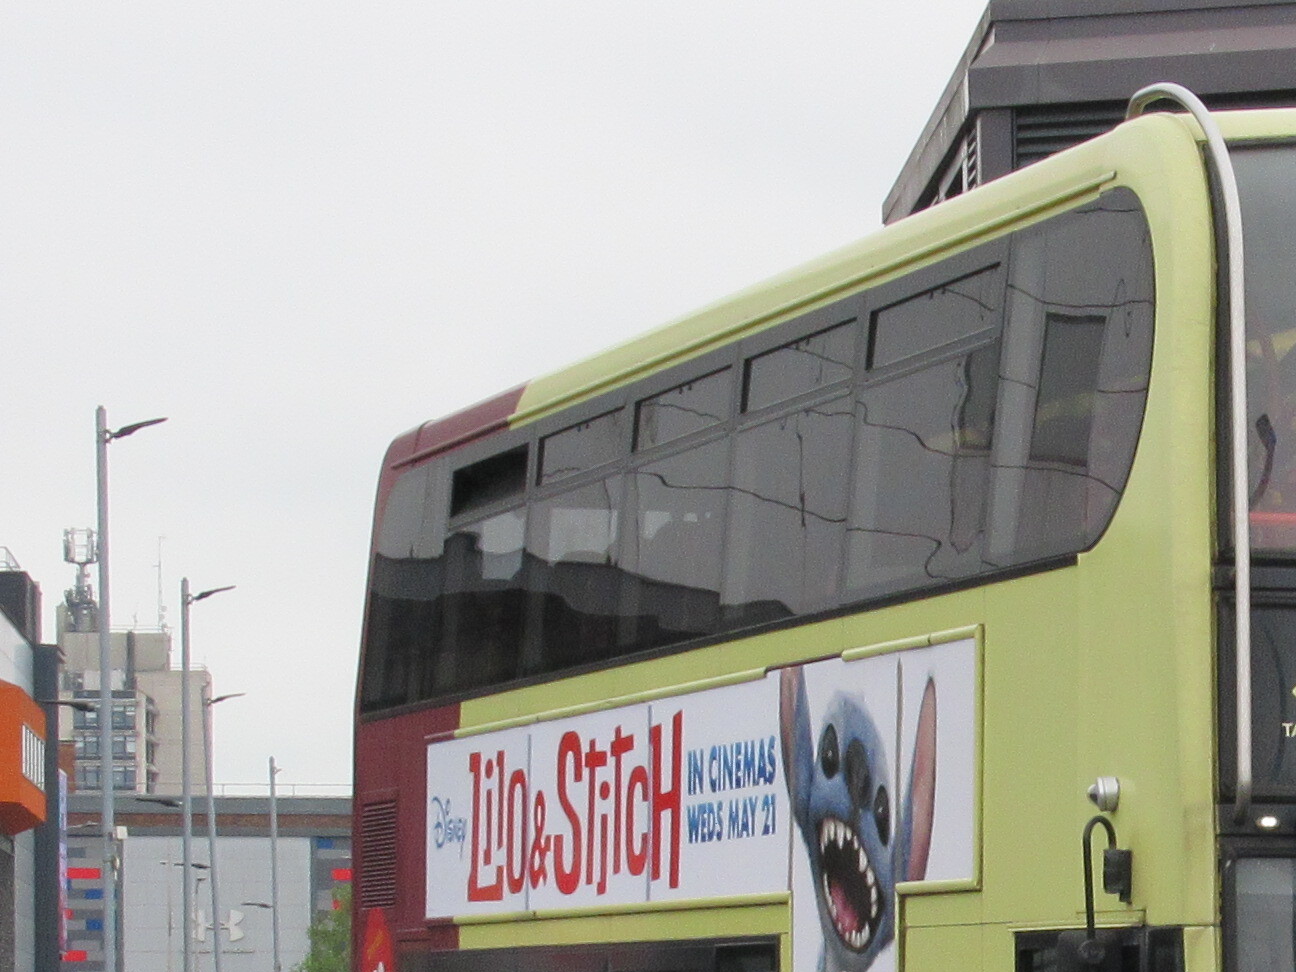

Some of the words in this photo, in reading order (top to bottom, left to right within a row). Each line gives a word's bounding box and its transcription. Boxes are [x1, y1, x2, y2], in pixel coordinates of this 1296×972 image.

[687, 748, 704, 796] IN
[708, 734, 776, 793] CINEMAS
[686, 800, 724, 844] WEDS
[727, 795, 758, 840] MAY
[760, 793, 777, 836] 21
